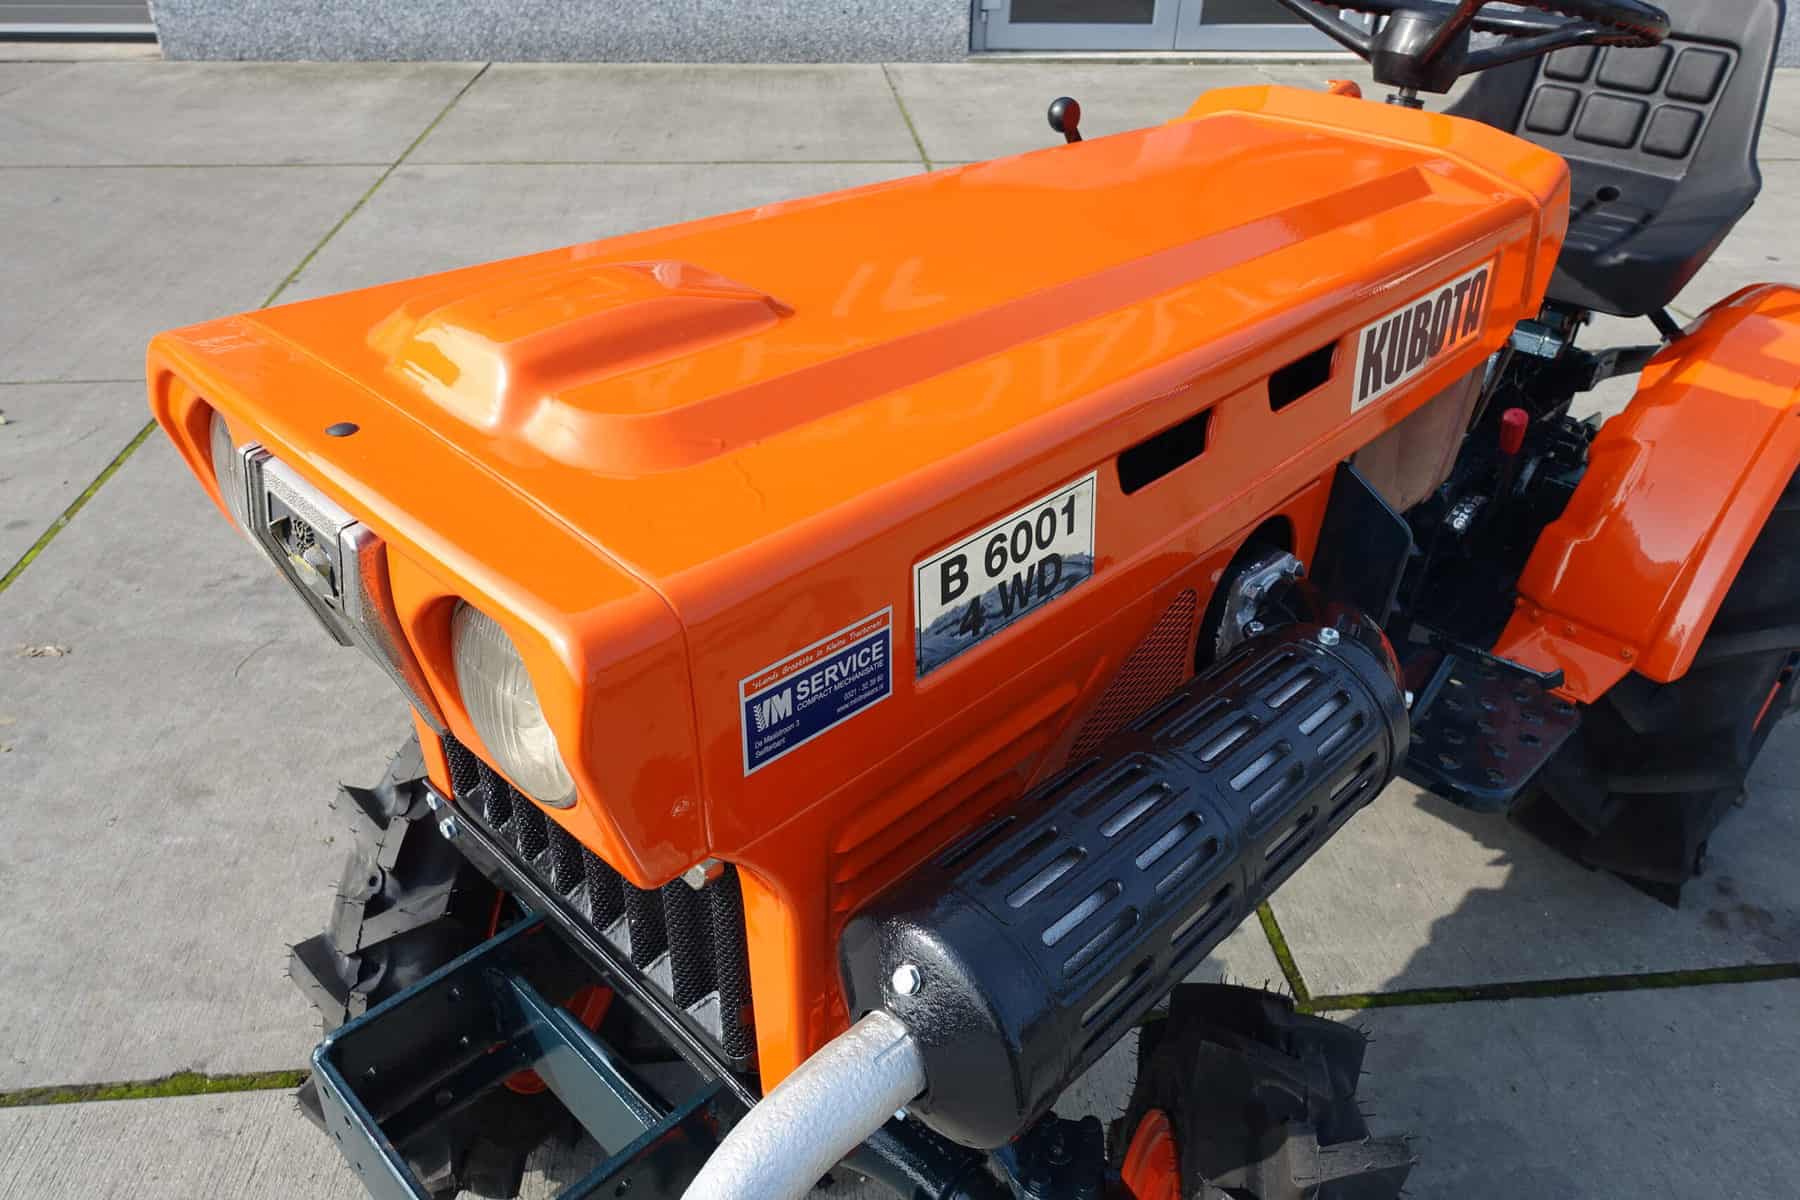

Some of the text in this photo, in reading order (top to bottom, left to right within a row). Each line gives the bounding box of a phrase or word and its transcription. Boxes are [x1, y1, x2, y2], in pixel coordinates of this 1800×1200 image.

[1358, 269, 1489, 402] KUBOTA
[940, 494, 1076, 606] B 6001
[959, 552, 1063, 637] 4 WD
[796, 639, 885, 701] SERVICE
[797, 685, 832, 711] COMPACT
